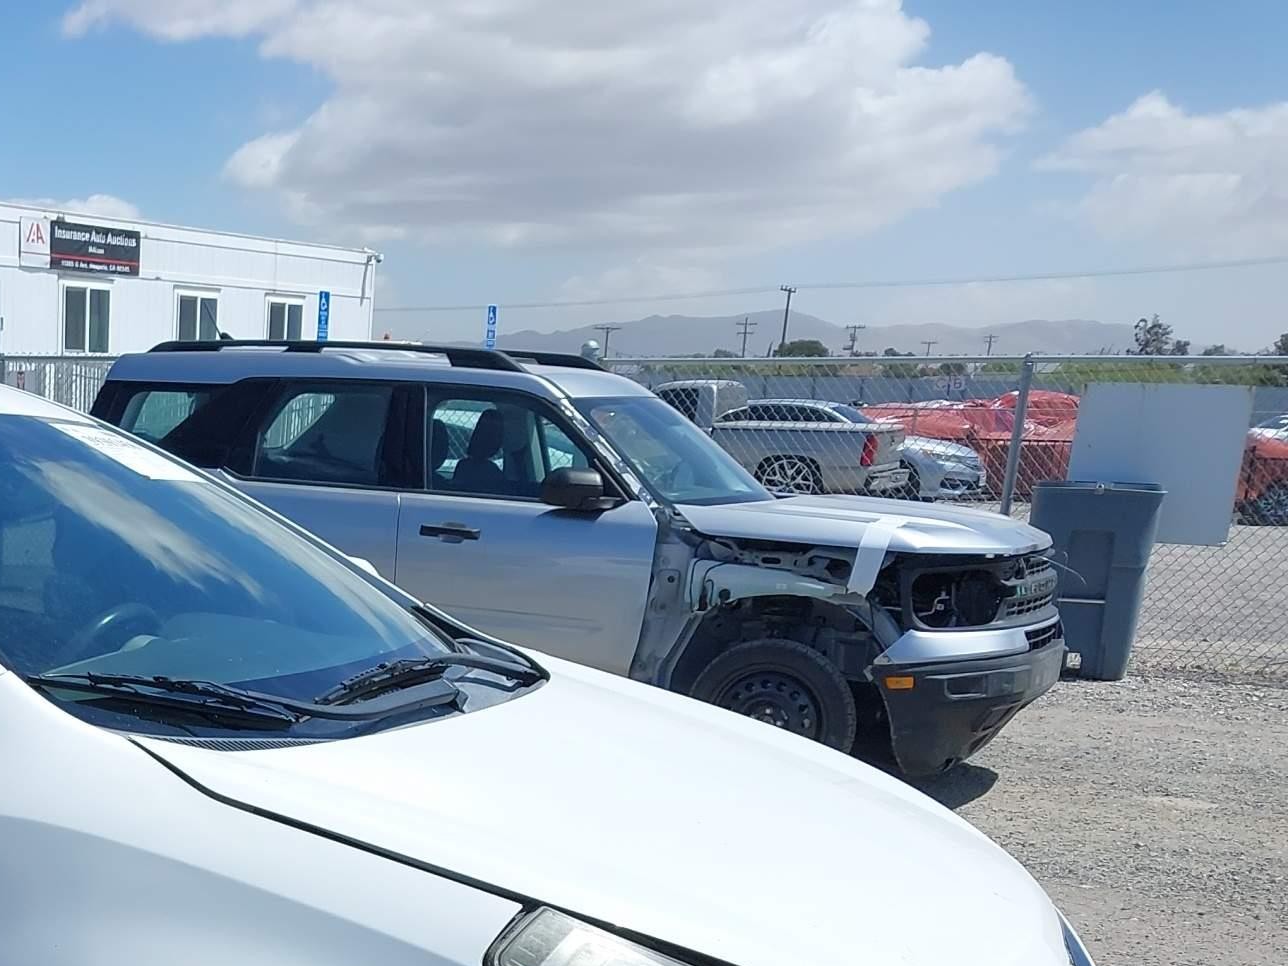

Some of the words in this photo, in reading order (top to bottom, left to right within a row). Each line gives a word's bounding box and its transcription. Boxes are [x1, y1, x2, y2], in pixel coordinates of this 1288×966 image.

[55, 225, 90, 241] Insurance
[90, 230, 106, 244] Auto
[106, 232, 137, 247] Auctions
